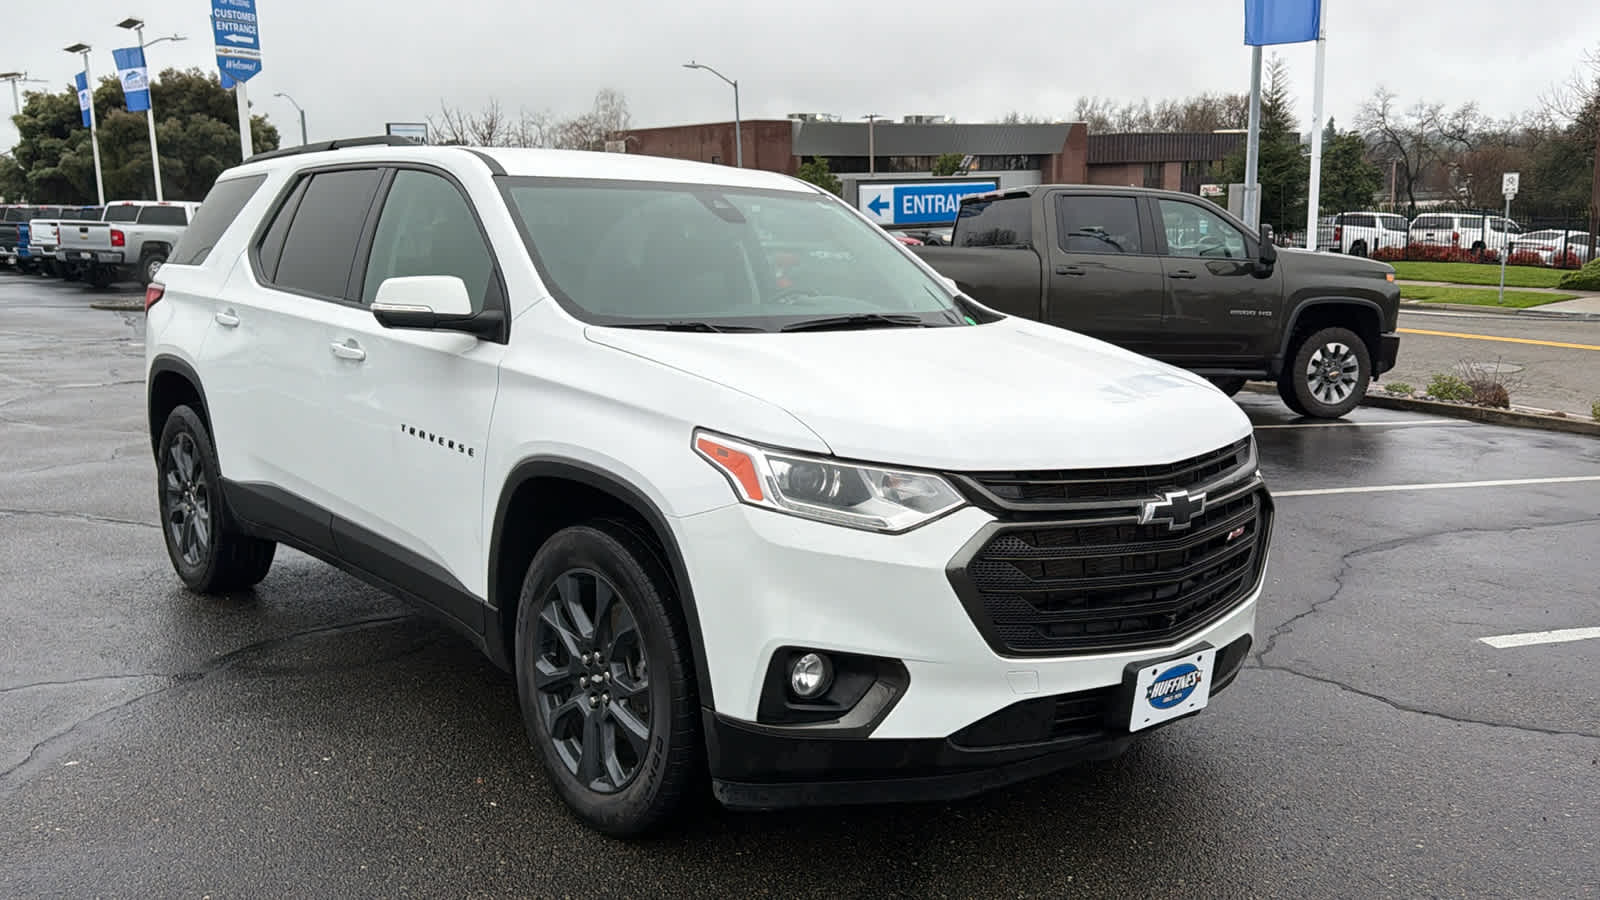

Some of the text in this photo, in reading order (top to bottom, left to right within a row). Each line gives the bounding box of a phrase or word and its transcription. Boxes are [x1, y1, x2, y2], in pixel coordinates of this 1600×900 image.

[214, 8, 256, 21] CUSTOMER
[216, 21, 257, 34] ENTRANCE
[400, 423, 474, 457] TRAVERSE
[1150, 670, 1200, 698] HUFFINES
